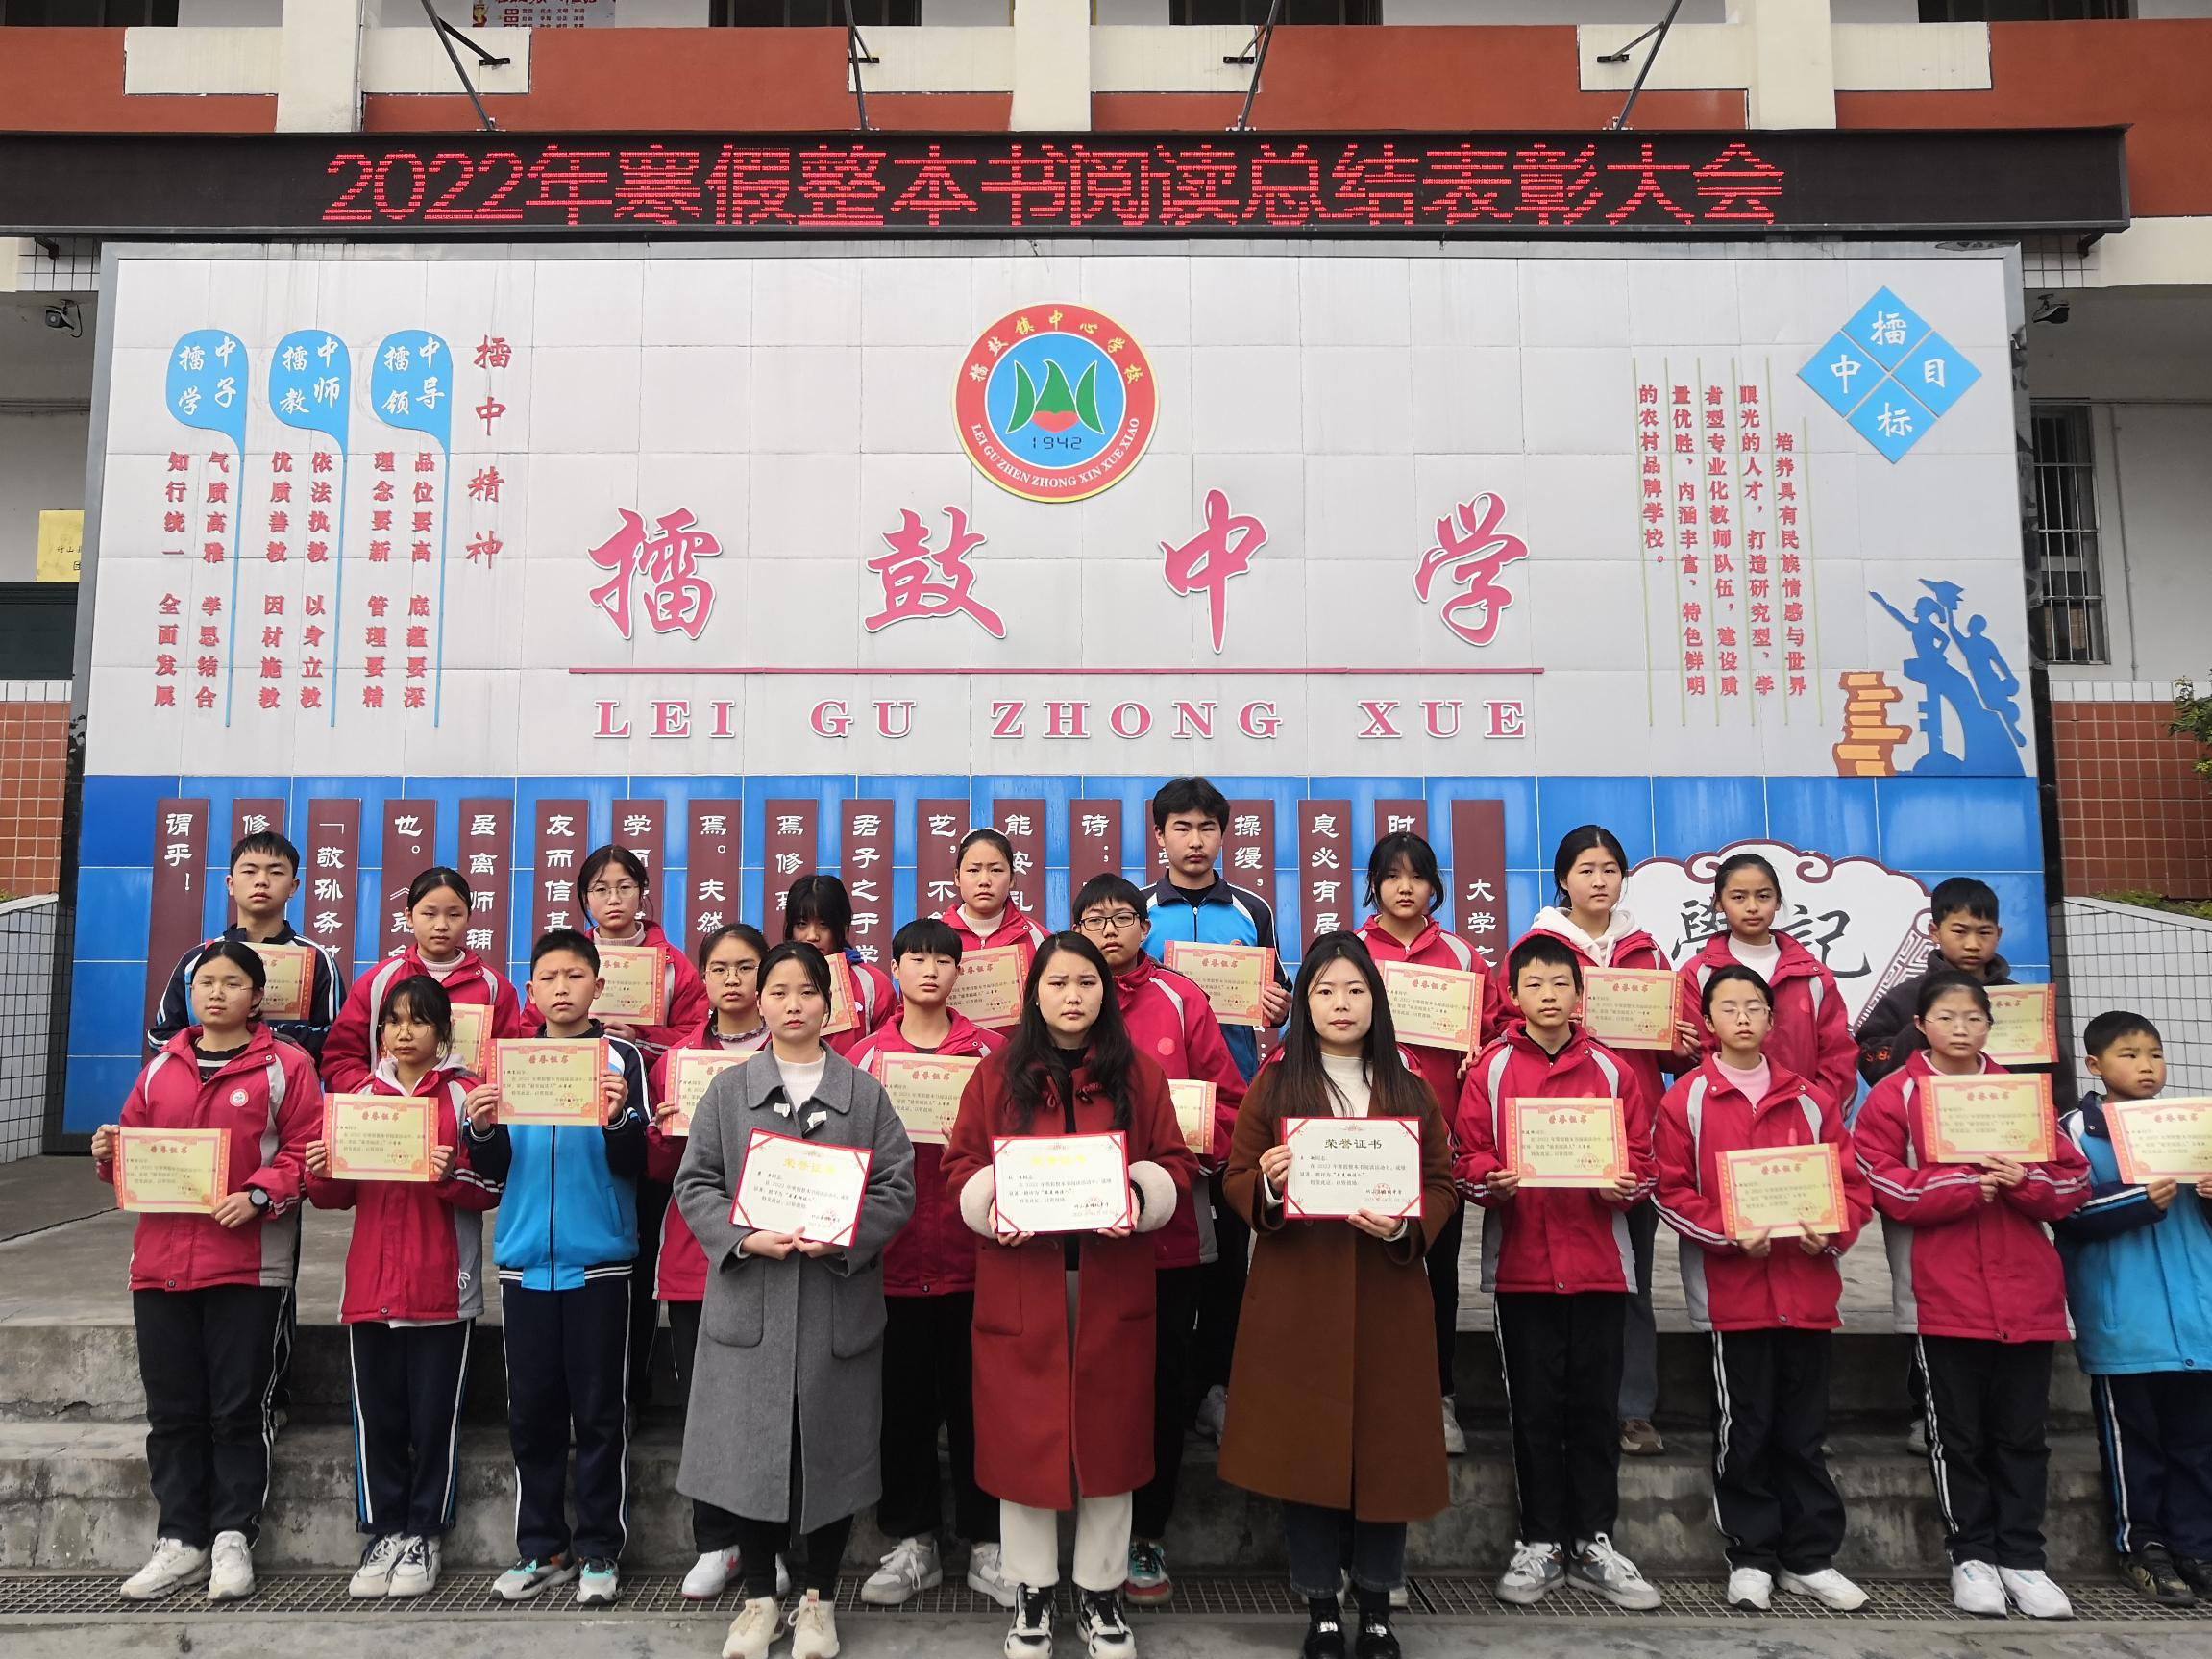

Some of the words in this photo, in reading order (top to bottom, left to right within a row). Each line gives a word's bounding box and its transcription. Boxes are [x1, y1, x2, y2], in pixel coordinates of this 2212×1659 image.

[324, 143, 1786, 227] 2022年寒假整本书阅读总结表彰大会
[971, 423, 986, 448] LEI
[984, 444, 1000, 462] GU
[996, 458, 1031, 484] ZHEN
[1031, 475, 1077, 488] ZHONG
[1078, 467, 1102, 484] XIN
[1100, 449, 1122, 472] XUE
[1118, 418, 1140, 454] XIAO
[1032, 436, 1082, 450] 1942
[587, 488, 1530, 654] 擂鼓中学
[1775, 432, 1806, 696] 培养具有民族情感与世界
[594, 698, 736, 739] LEI
[809, 698, 916, 739] GU
[991, 698, 1284, 739] ZHONG
[1358, 698, 1527, 739] XUE
[1324, 1138, 1382, 1150] 荣誉证书
